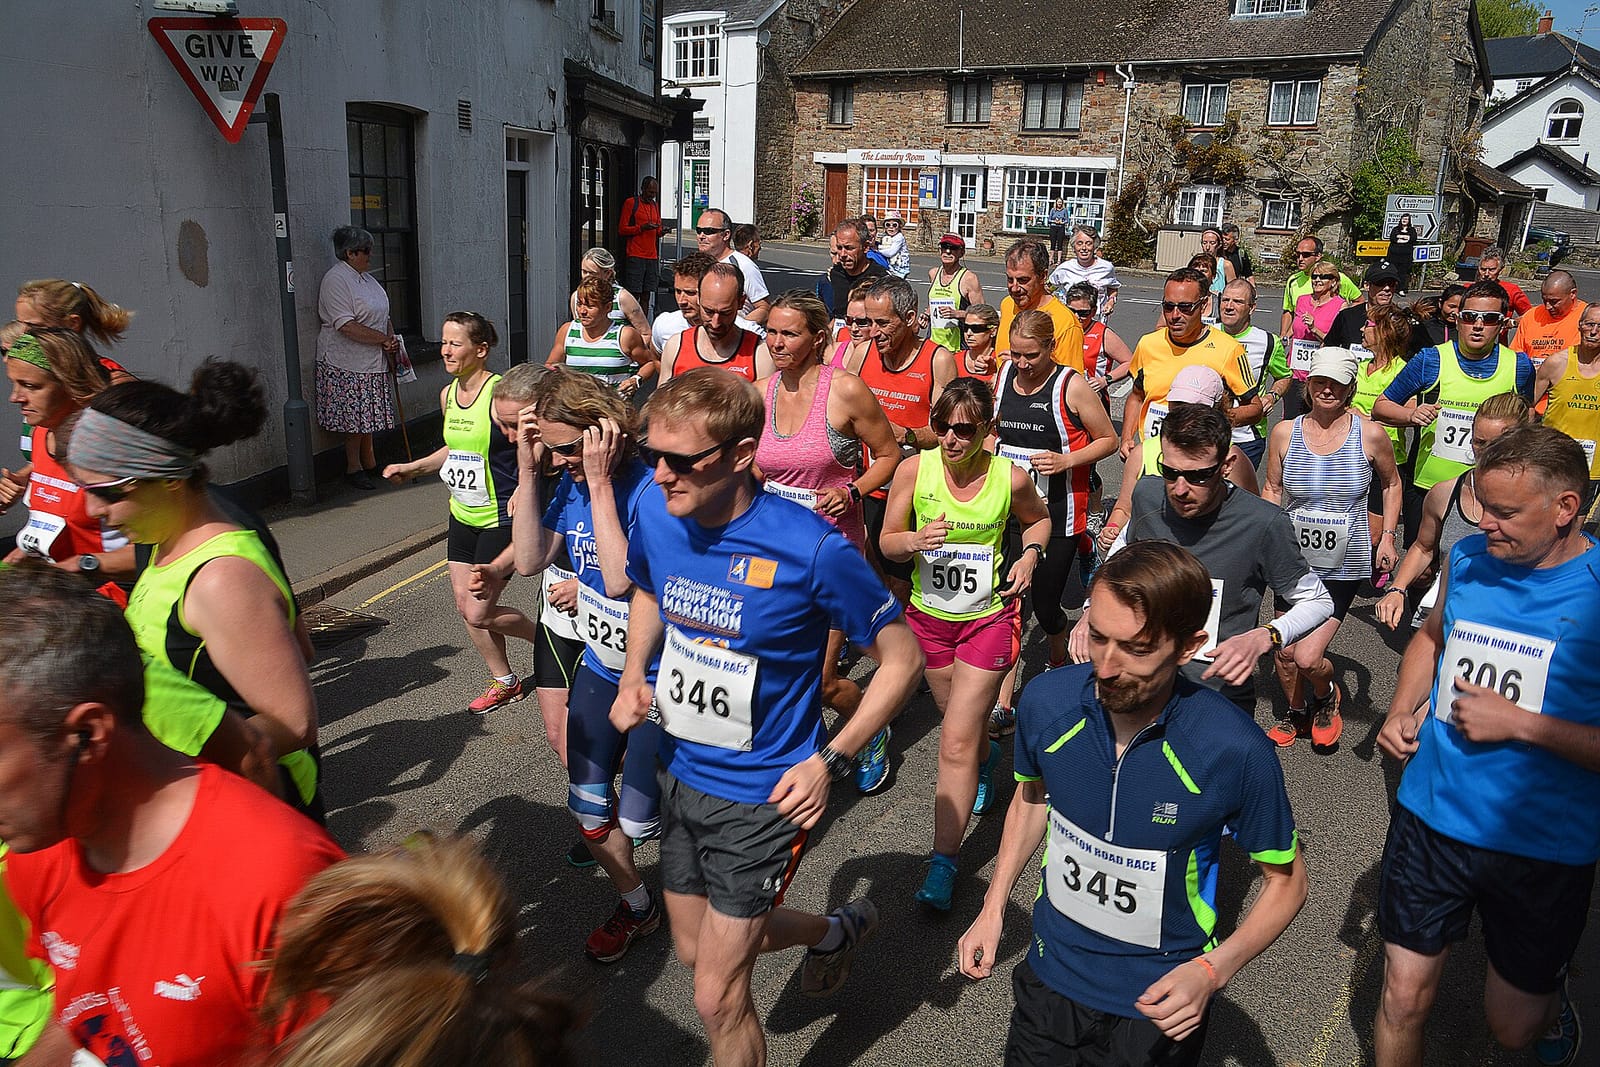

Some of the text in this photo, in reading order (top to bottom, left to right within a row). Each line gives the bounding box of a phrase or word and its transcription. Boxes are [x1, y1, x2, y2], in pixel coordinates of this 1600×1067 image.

[185, 34, 256, 58] GIVE
[200, 66, 245, 81] WAY
[861, 151, 925, 163] The Laundry Room
[889, 391, 921, 402] MOLTON
[1572, 393, 1598, 402] AVON
[1032, 424, 1045, 432] RC
[447, 467, 477, 490] 322
[956, 522, 975, 530] ROAD
[1300, 528, 1337, 551] 538
[972, 552, 990, 562] RACE
[932, 564, 978, 594] 505
[580, 591, 603, 611] TIVERTON
[604, 605, 622, 619] ROAD
[664, 581, 744, 614] CARDIFF HALF
[662, 594, 742, 631] MARATHON
[588, 612, 627, 652] 523
[1490, 638, 1517, 653] ROAD
[1519, 644, 1544, 659] RACE
[1457, 657, 1522, 705] 306
[669, 668, 729, 718] 346
[1151, 816, 1177, 825] RUN
[1053, 818, 1157, 872] TIVERTON ROAD RACE
[1063, 854, 1137, 914] 345
